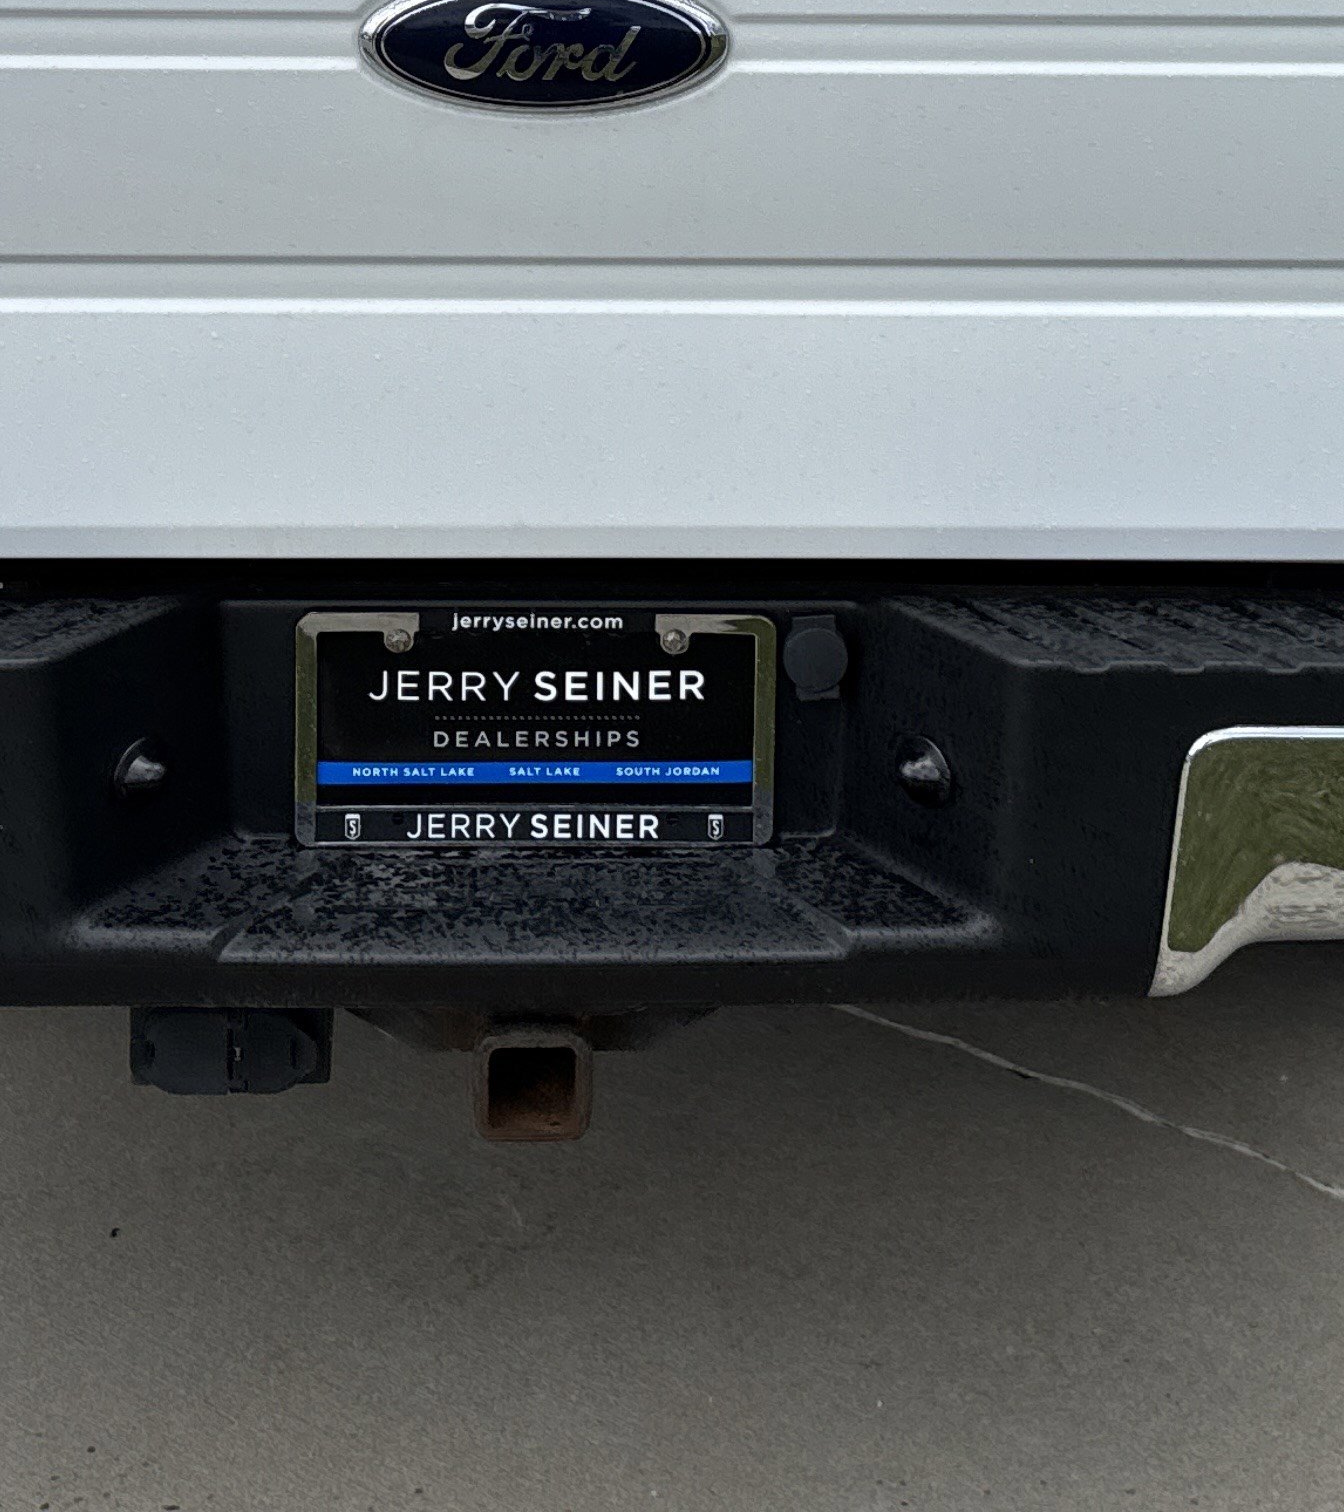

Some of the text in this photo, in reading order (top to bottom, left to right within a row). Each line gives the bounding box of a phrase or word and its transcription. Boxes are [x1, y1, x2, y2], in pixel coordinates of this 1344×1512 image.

[443, 3, 642, 82] Ford
[452, 612, 623, 631] jerryseiner.com
[368, 669, 706, 702] JERRY SEINER
[433, 730, 641, 749] DEALERSHIPS
[352, 767, 474, 777] NORTH SALT LAKE
[509, 767, 580, 776] SALT LAKE
[616, 766, 720, 776] SOUTH JORDAN
[407, 813, 659, 839] JERRY SEINER
